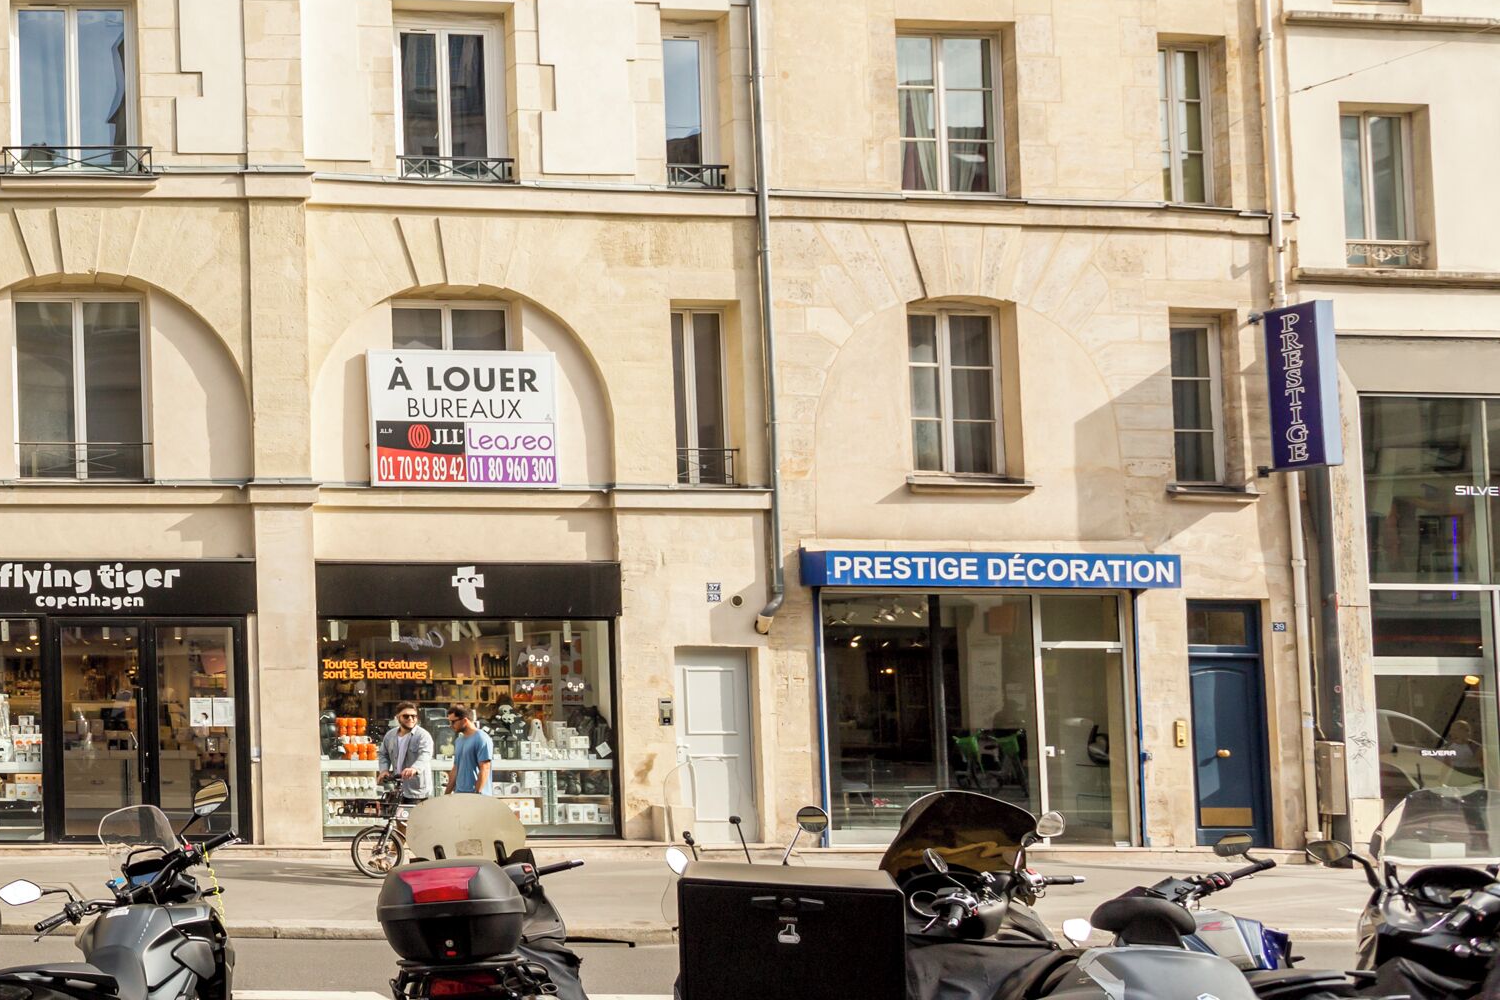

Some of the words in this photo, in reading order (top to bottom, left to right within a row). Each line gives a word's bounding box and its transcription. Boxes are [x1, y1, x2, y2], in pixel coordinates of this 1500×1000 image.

[387, 356, 412, 391] À
[426, 366, 539, 393] LOUER
[1280, 313, 1309, 463] PRESTIGE
[407, 397, 522, 419] BUREAUX
[380, 455, 395, 480] 01
[397, 456, 413, 480] 70
[414, 456, 430, 481] 93
[432, 456, 447, 481] 89
[449, 456, 465, 481] 42
[469, 456, 484, 481] 01
[488, 456, 503, 481] 80
[506, 457, 529, 482] 960
[531, 457, 554, 482] 300
[96, 562, 181, 594] tiger
[833, 556, 979, 580] PRESTIGE
[987, 554, 1174, 583] DÉCORATION
[35, 593, 145, 610] copenhagen
[1274, 623, 1285, 631] 39
[322, 659, 359, 670] Toutes
[360, 659, 376, 669] les
[378, 659, 428, 670] créatures
[323, 669, 348, 679] sont
[349, 669, 365, 679] les
[366, 669, 427, 680] bienvenues
[1421, 749, 1457, 757] SILVERA
